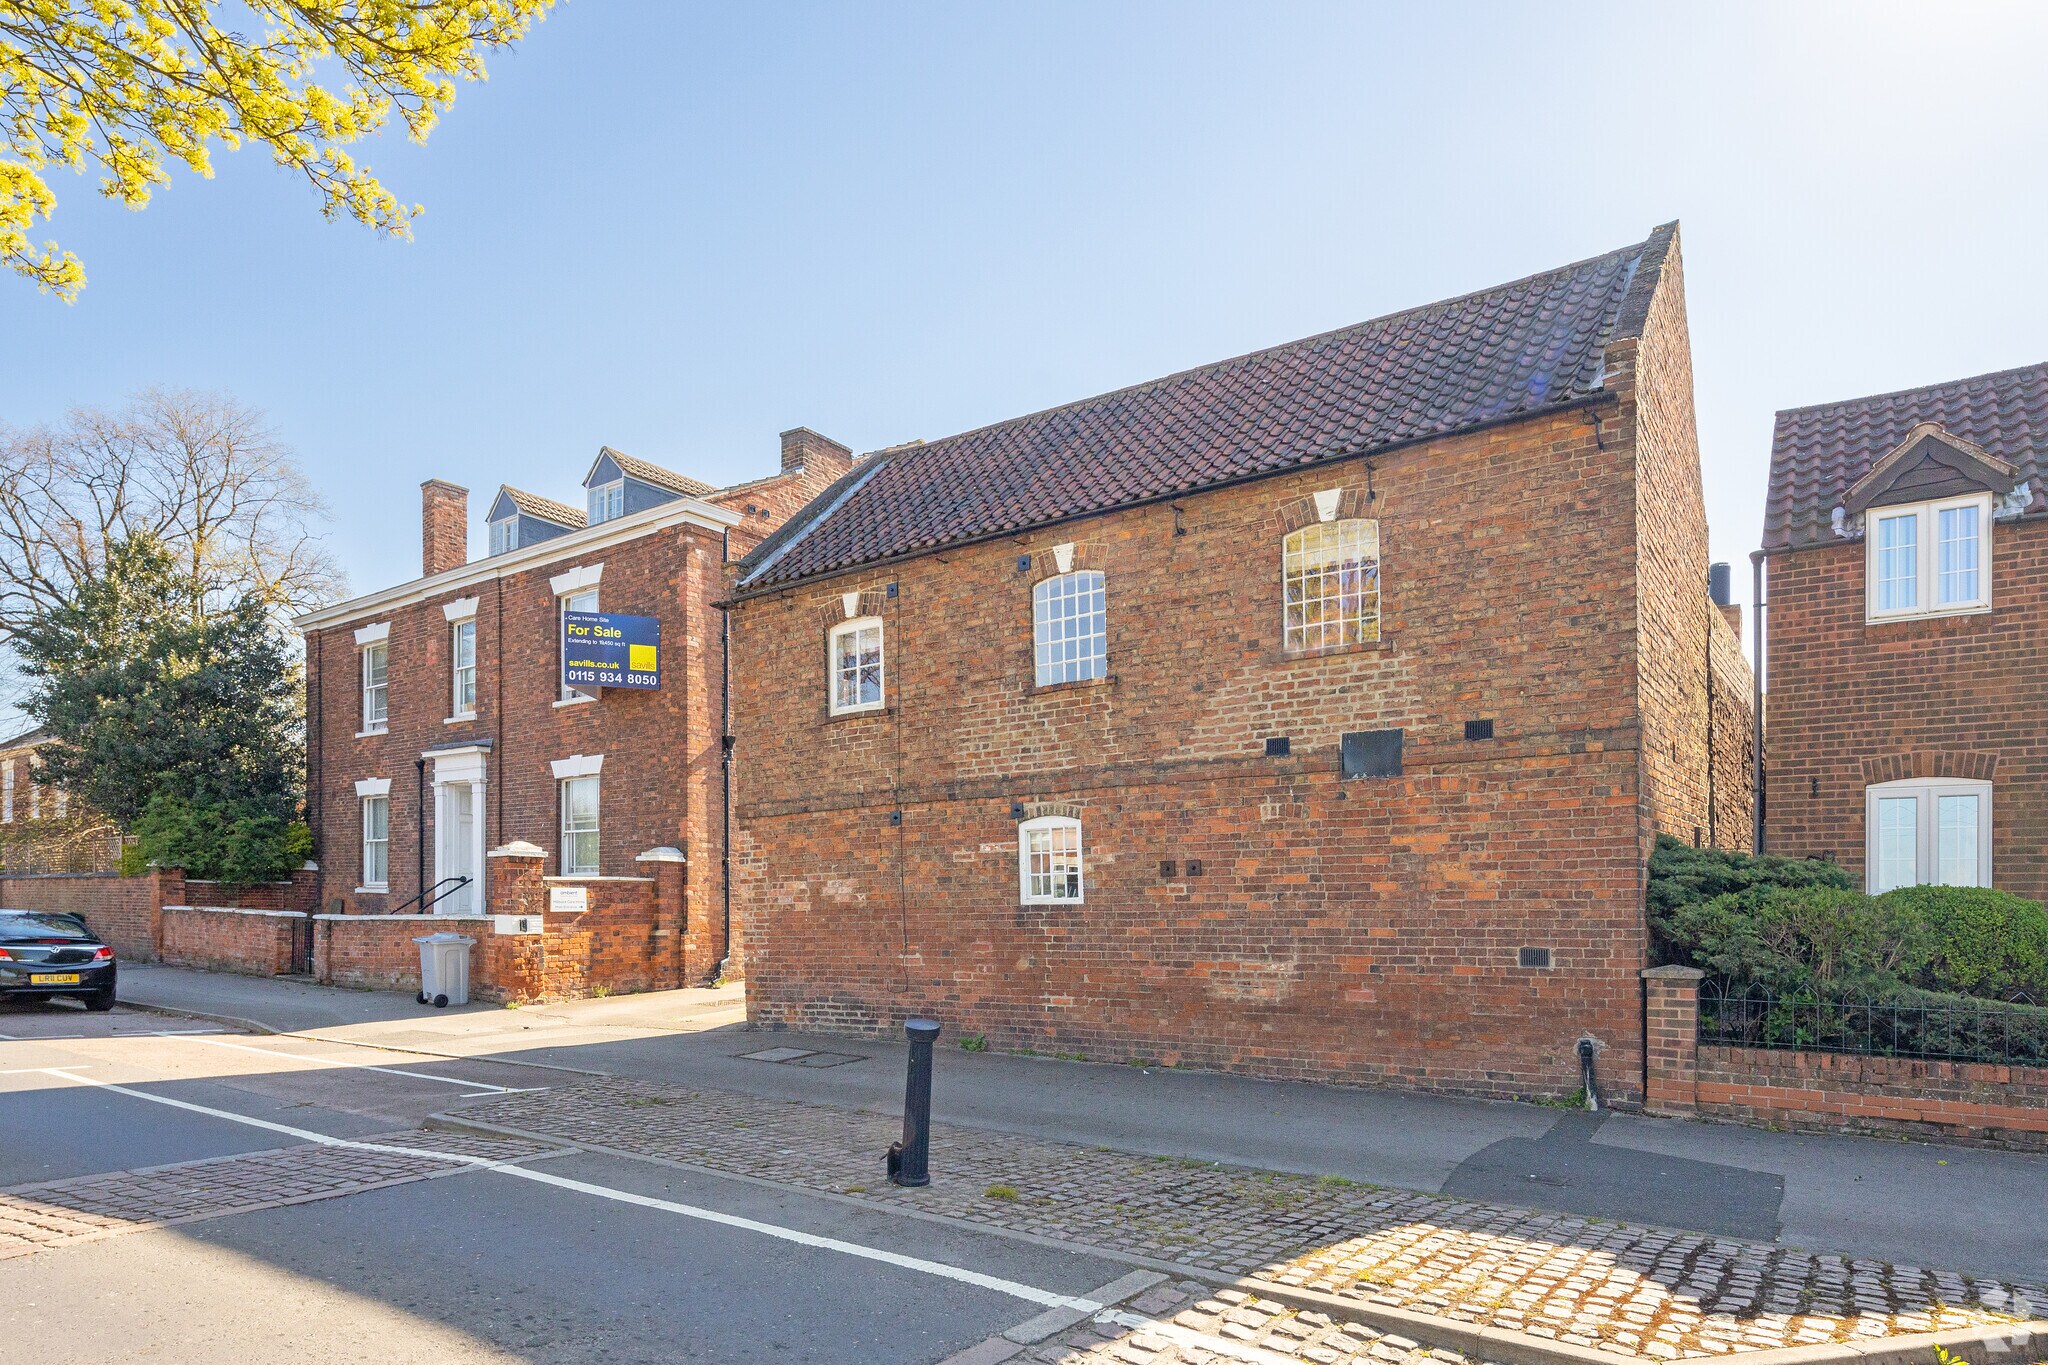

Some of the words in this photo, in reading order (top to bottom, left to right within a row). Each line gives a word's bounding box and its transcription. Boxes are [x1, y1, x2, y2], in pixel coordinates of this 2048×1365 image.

[568, 624, 590, 636] For
[593, 625, 622, 638] Sale
[569, 660, 620, 669] savills.co.uk
[631, 662, 656, 670] savills
[569, 670, 595, 681] 0115
[599, 672, 623, 683] 934
[627, 674, 657, 685] 8050
